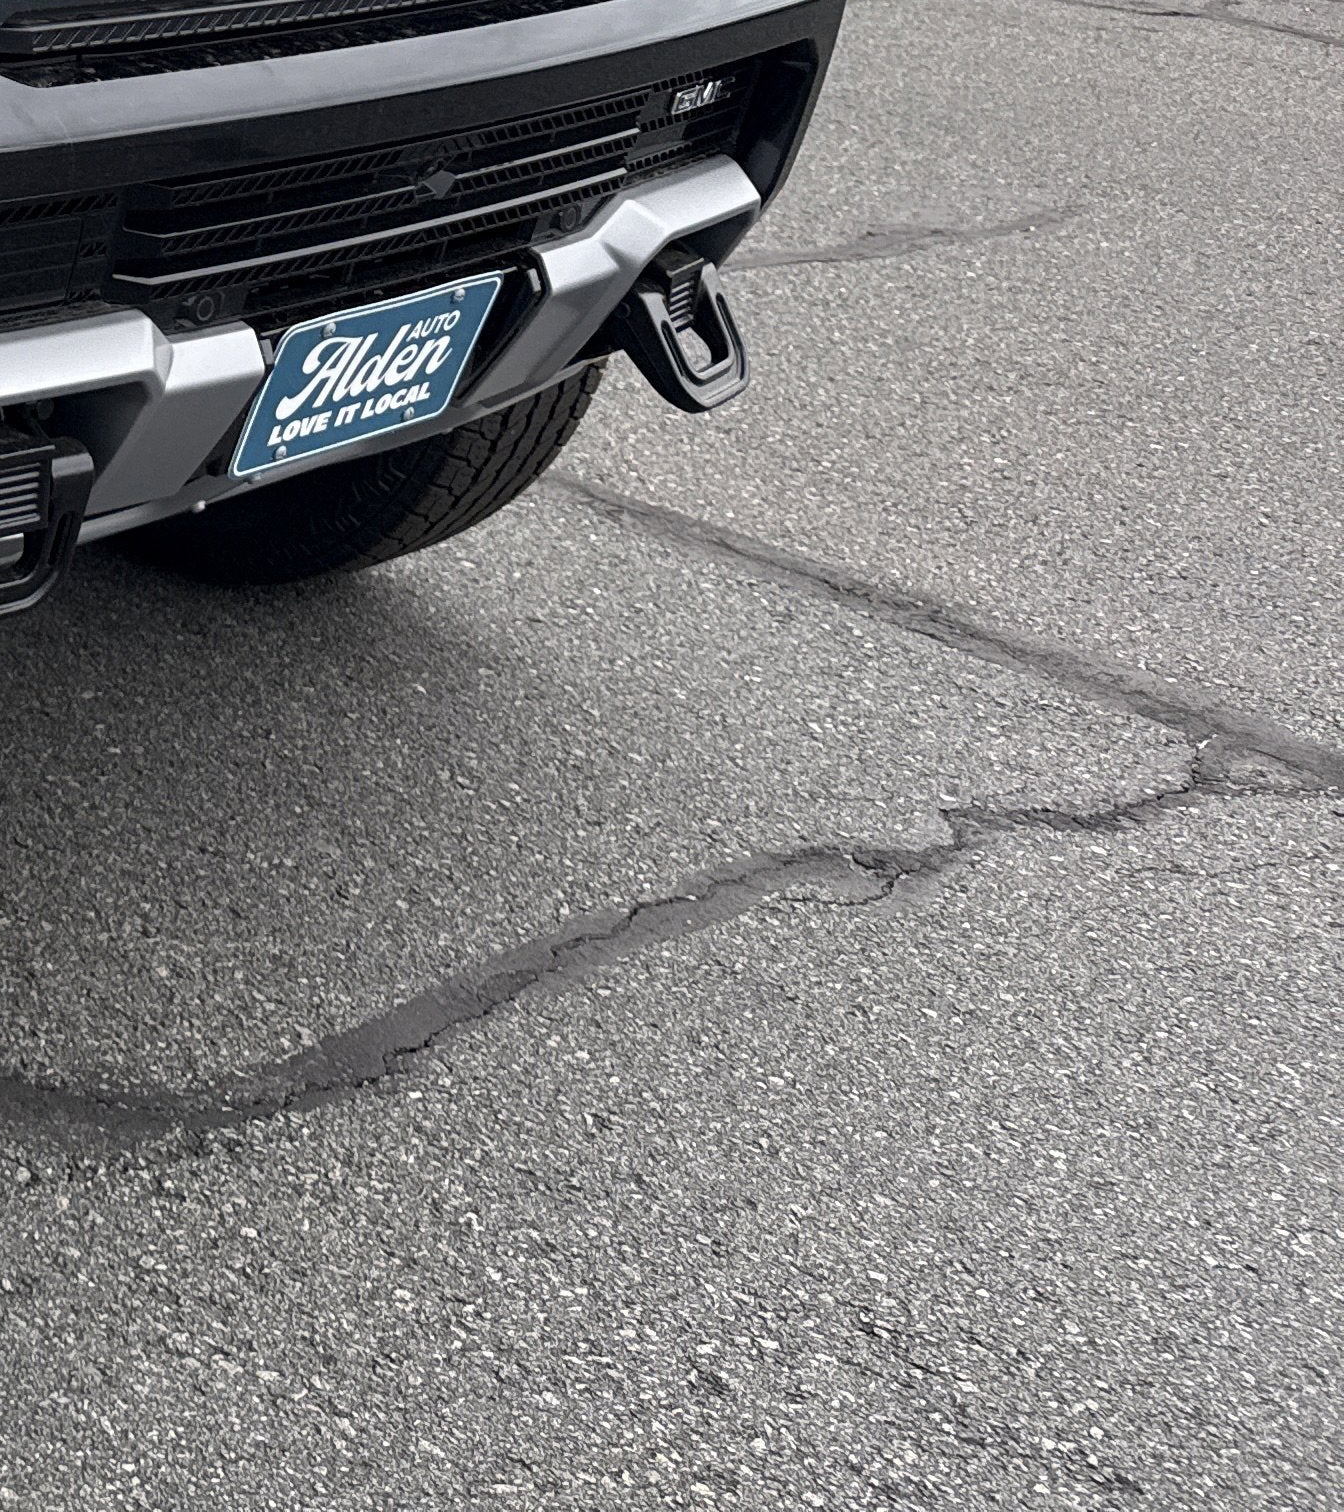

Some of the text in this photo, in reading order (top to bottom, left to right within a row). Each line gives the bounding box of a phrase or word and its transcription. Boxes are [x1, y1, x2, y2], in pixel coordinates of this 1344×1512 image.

[671, 76, 736, 115] GMC
[406, 309, 461, 342] AUTO
[275, 324, 452, 421] Alden
[267, 382, 431, 446] LOVE IT LOCAL
